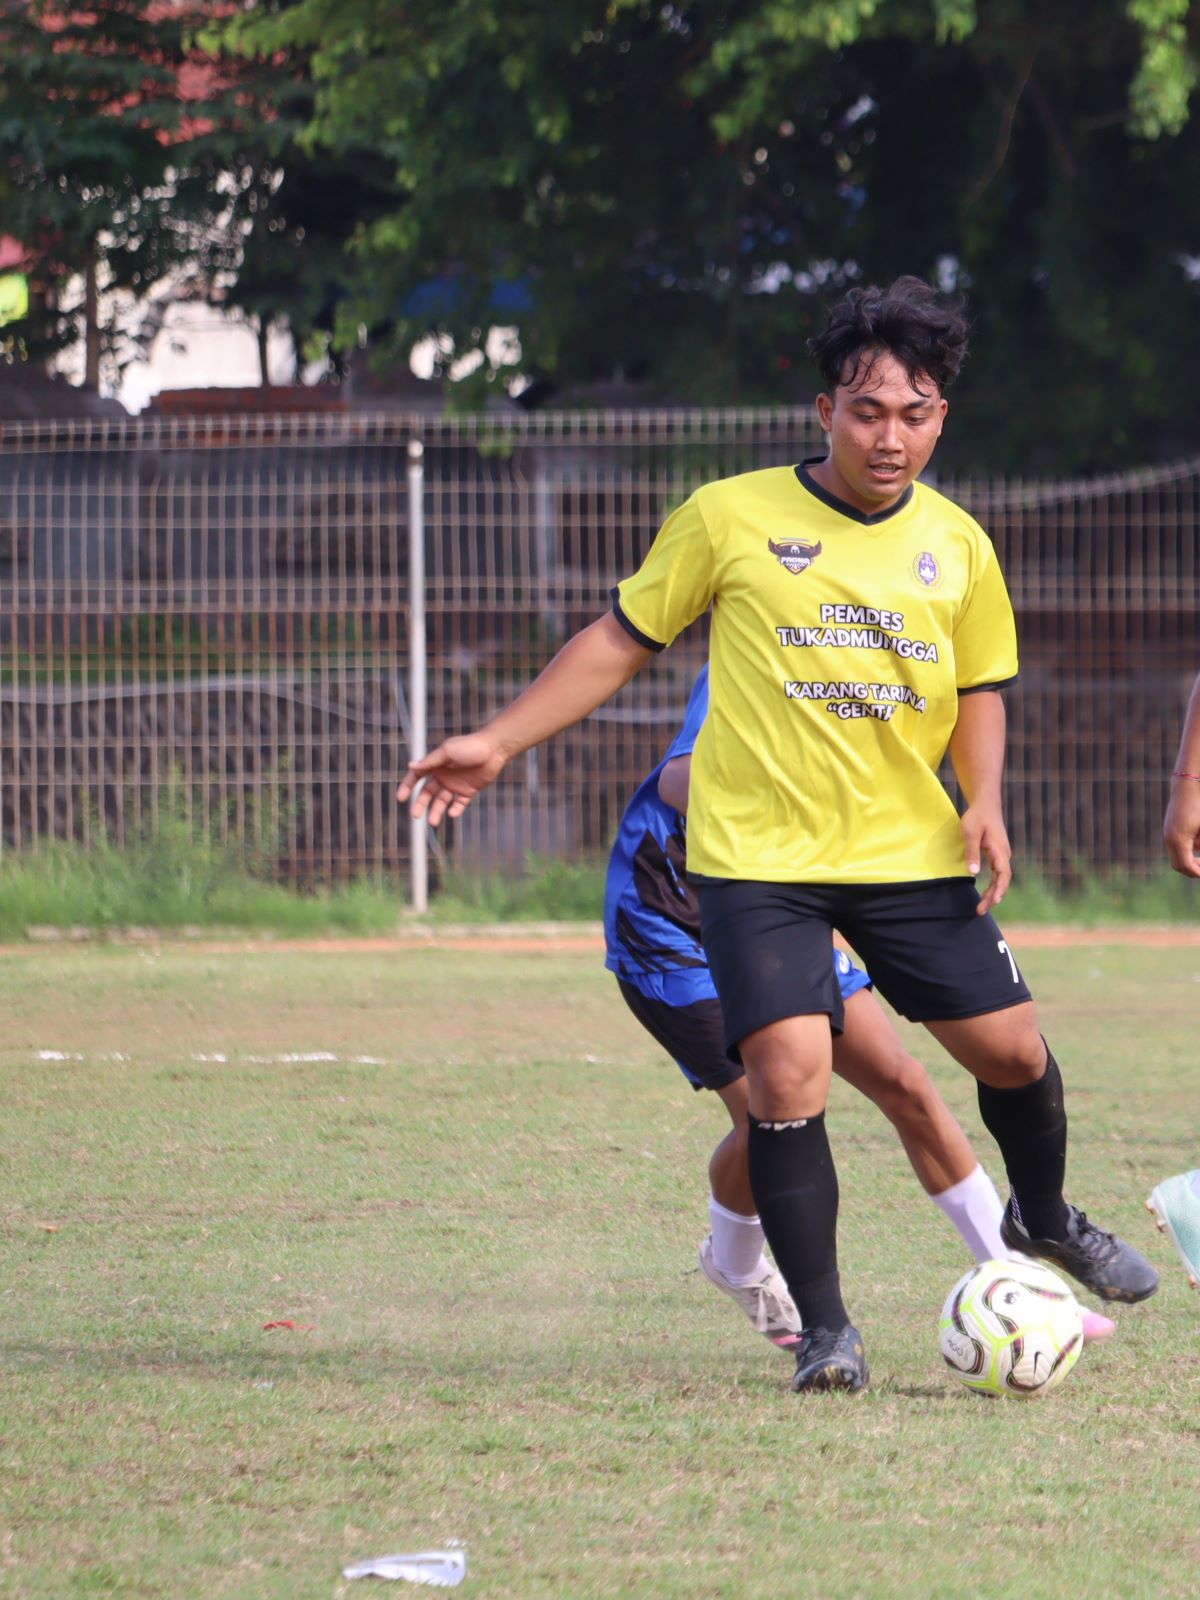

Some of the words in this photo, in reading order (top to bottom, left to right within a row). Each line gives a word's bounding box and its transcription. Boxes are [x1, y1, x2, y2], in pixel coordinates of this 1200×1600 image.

[820, 604, 904, 632] PEMDES
[776, 627, 939, 663] TUKADMUNGGA
[784, 681, 868, 700] KARANG
[997, 940, 1020, 984] 7
